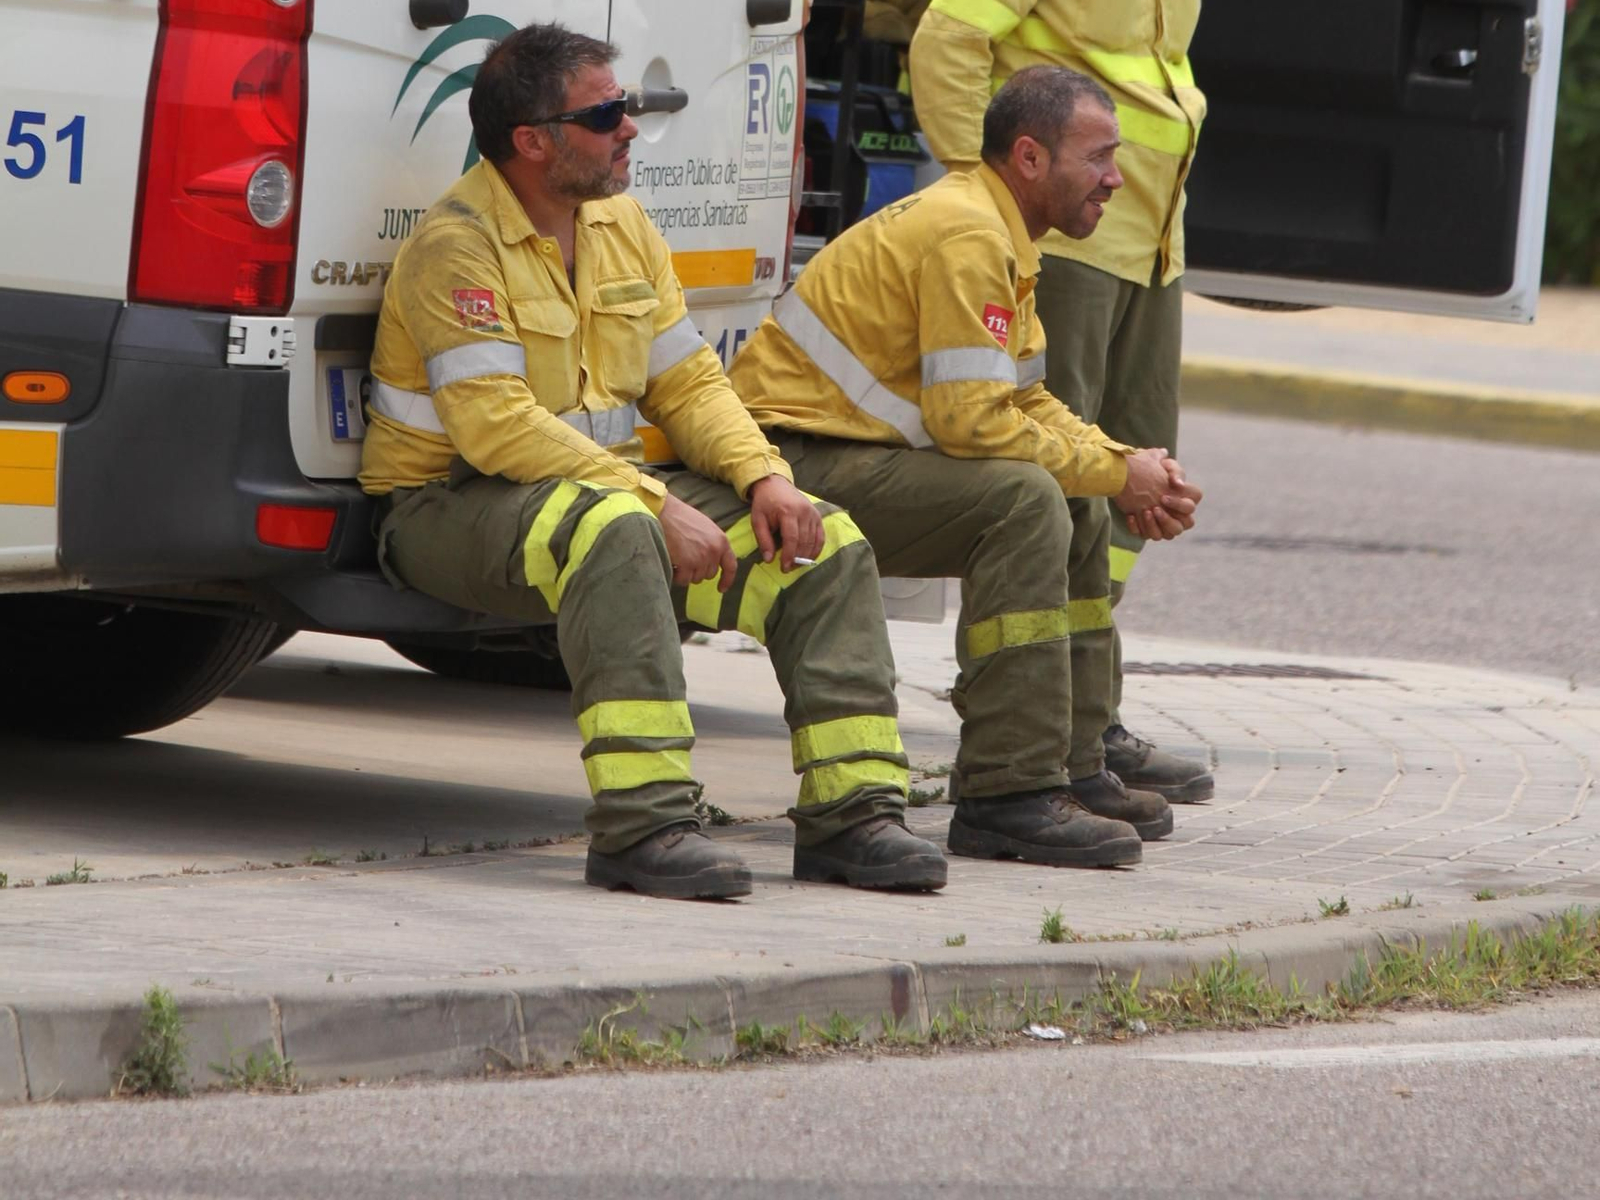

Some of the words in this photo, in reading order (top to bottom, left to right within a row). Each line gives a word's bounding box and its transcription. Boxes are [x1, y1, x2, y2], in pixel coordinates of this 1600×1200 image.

[4, 110, 86, 185] 51
[635, 161, 683, 195] Empresa
[686, 157, 722, 186] Pública
[725, 157, 738, 185] de
[378, 208, 428, 240] JUNT
[645, 200, 700, 237] ergencias
[702, 199, 749, 227] Sanitarias
[311, 259, 394, 286] CRAFT
[336, 411, 345, 428] E
